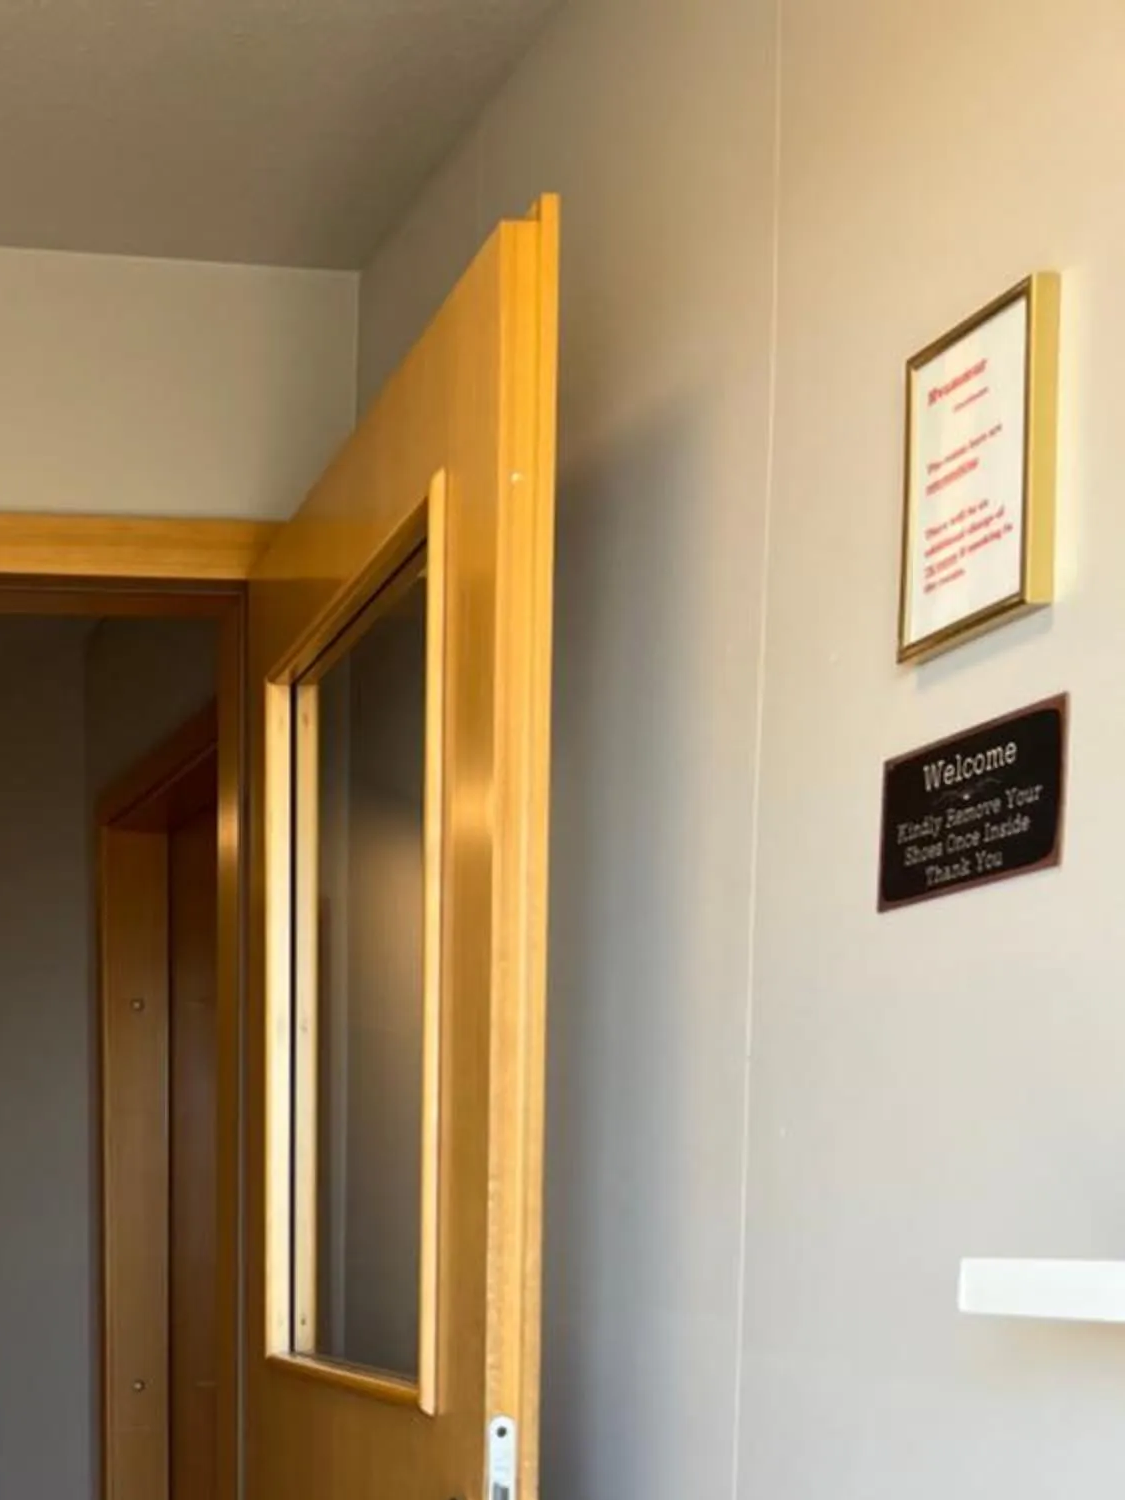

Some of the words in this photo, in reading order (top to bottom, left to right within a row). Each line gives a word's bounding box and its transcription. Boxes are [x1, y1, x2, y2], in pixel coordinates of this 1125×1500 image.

[923, 742, 1017, 791] Welcome
[897, 815, 943, 844] Kindly
[946, 798, 1001, 828] Remove
[1005, 785, 1043, 809] Your
[904, 841, 943, 866] Shoes
[946, 831, 980, 853] Once
[983, 813, 1030, 842] Inside
[926, 857, 971, 885] Thank
[976, 849, 1003, 872] You
